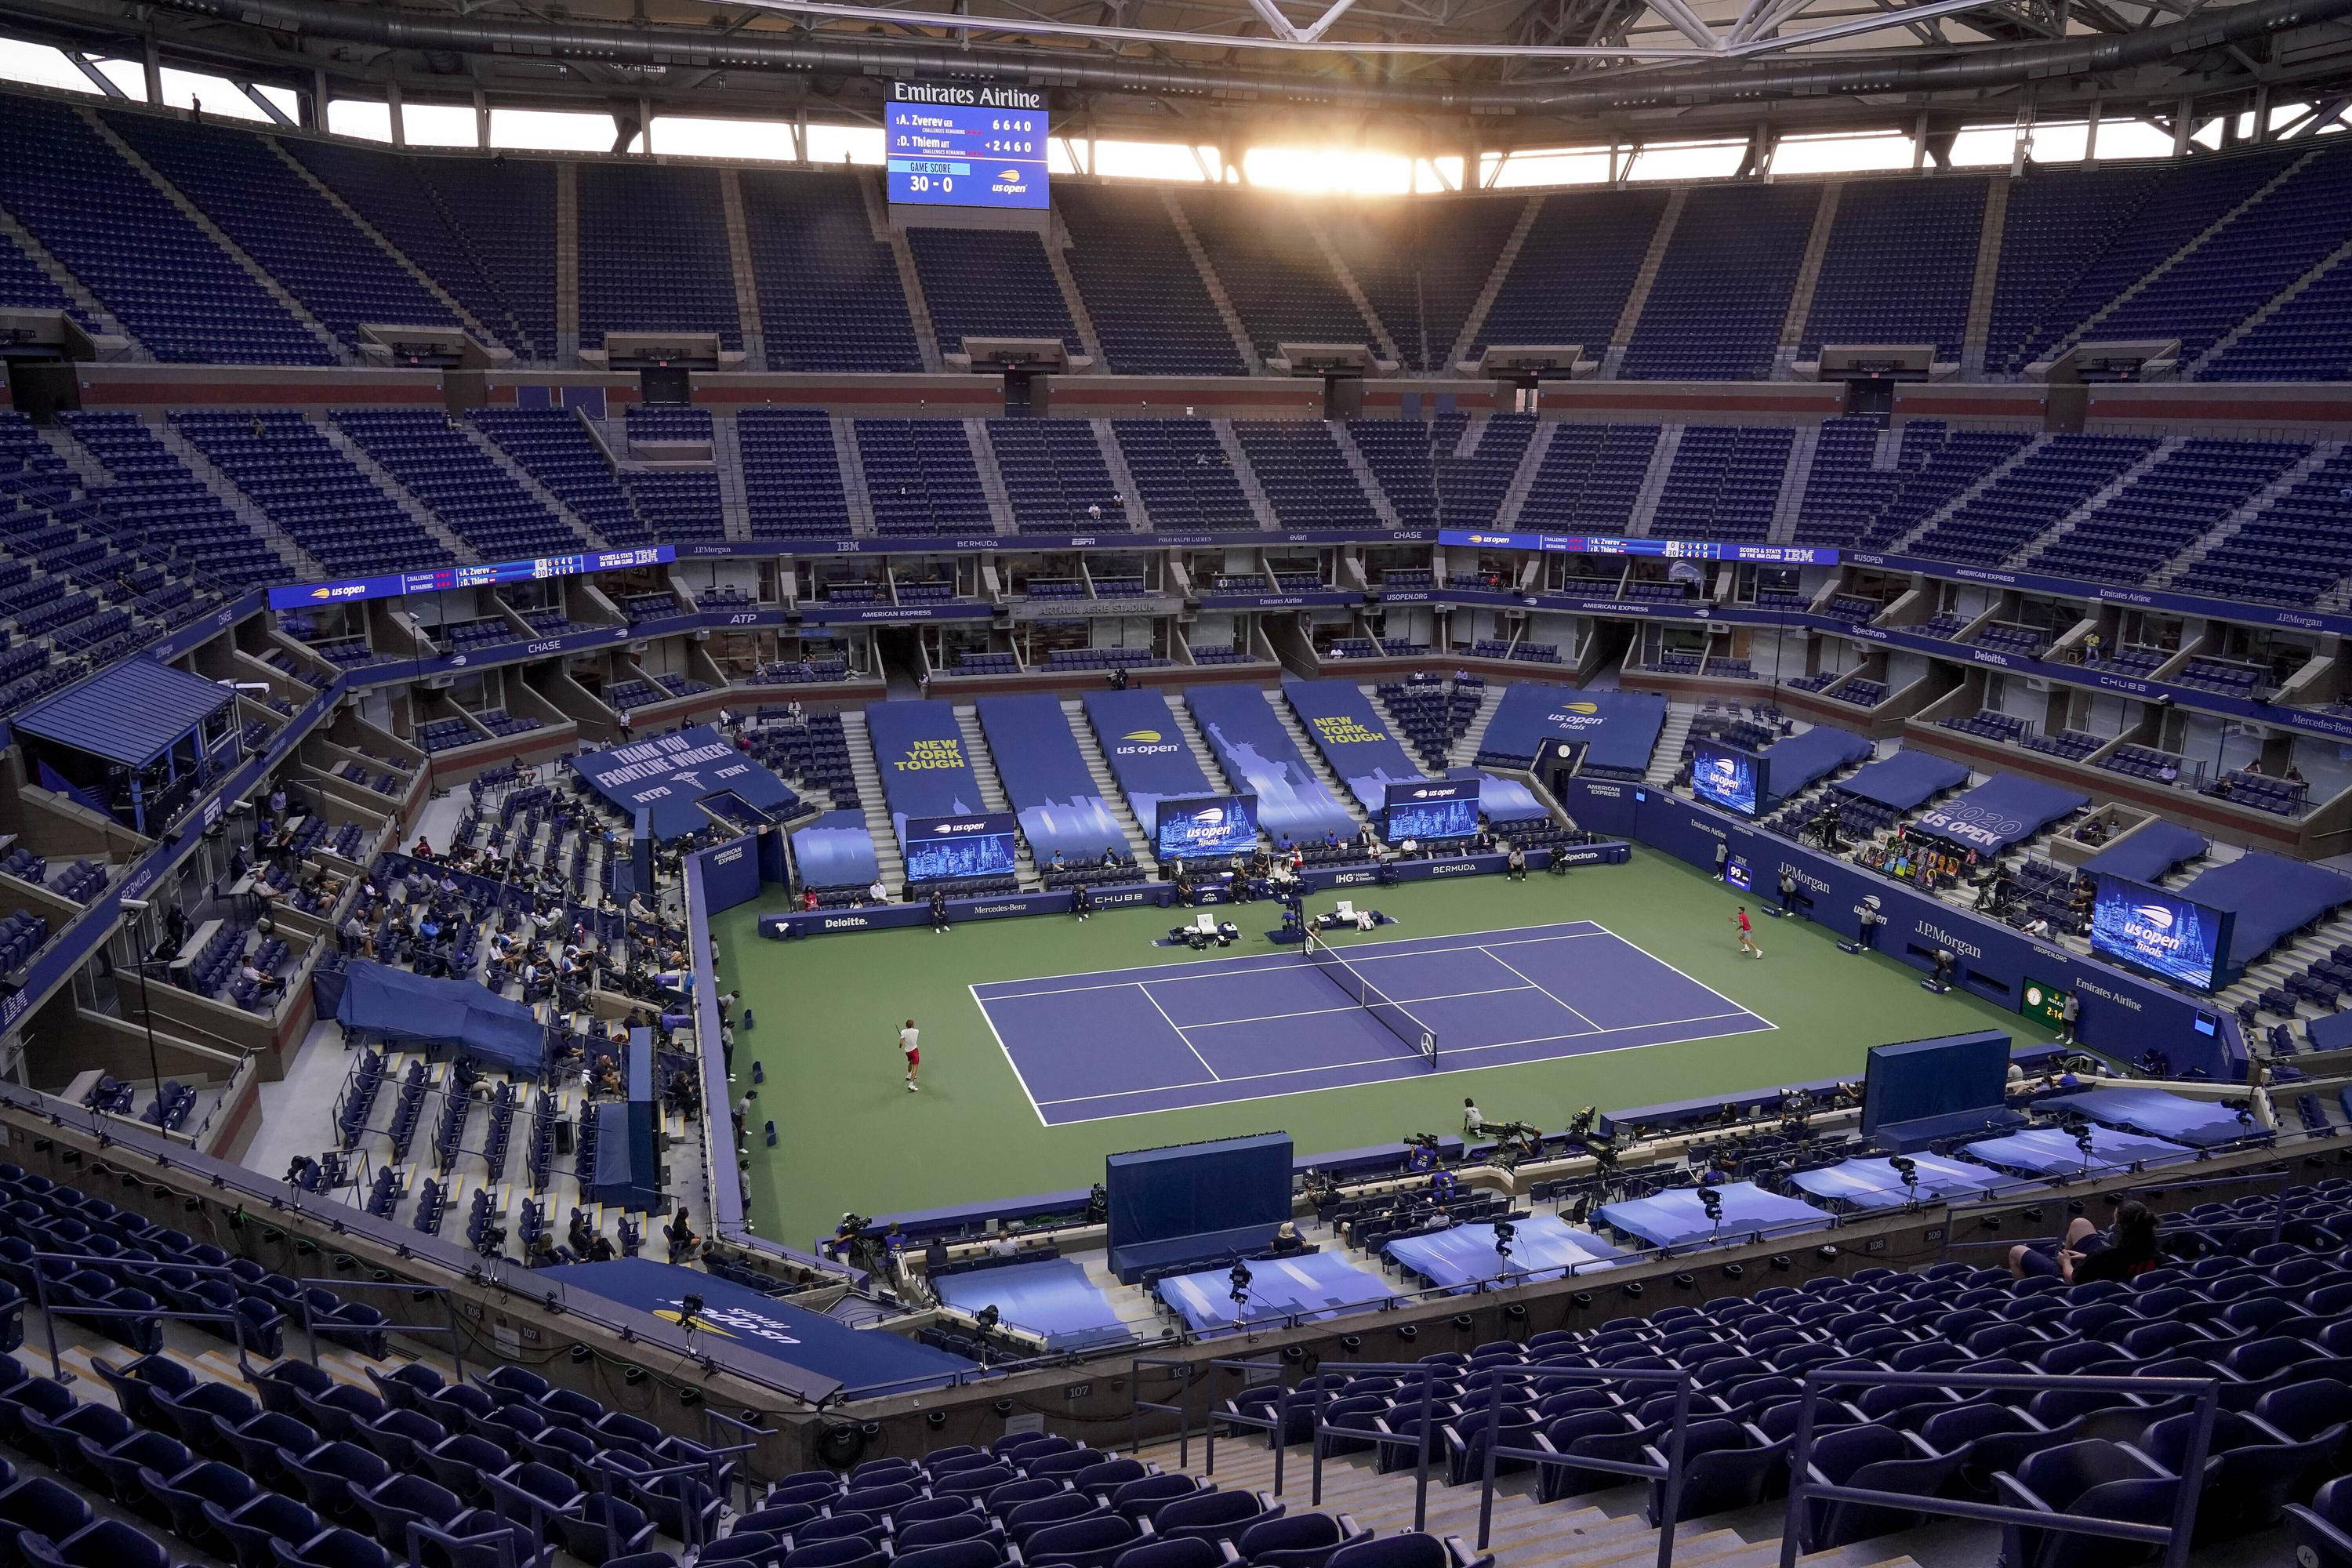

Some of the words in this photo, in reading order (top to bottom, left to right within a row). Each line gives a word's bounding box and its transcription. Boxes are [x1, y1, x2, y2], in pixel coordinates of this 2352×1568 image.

[895, 82, 974, 104] Emirates
[979, 87, 1040, 108] Airline
[900, 114, 909, 125] A.
[912, 114, 943, 127] Zverev
[993, 119, 1000, 130] 6
[1003, 120, 1010, 131] 6
[1013, 120, 1021, 131] 4
[1024, 121, 1031, 132] 0
[901, 136, 910, 147] D.
[912, 136, 939, 147] Thiem
[993, 140, 1000, 151] 2
[1004, 141, 1010, 152] 4
[1014, 142, 1021, 152] 6
[1024, 142, 1031, 153] 0
[911, 162, 928, 172] GAME
[930, 162, 951, 173] SCORE
[910, 176, 928, 191] 30
[943, 177, 952, 192] 0
[1004, 184, 1025, 194] open
[1290, 533, 1307, 542] evian
[1393, 531, 1422, 539] CHASE
[693, 546, 731, 554] J.P.Morgan
[837, 541, 859, 552] IBM
[635, 549, 658, 564] IBM
[1784, 549, 1814, 563] IBM
[1853, 554, 1883, 564] #USOPEN
[463, 568, 469, 577] A.
[470, 566, 489, 575] Zverev
[1956, 569, 1987, 580] AMERICAN
[1987, 573, 2015, 583] EXPRESS
[470, 576, 488, 585] Thiem
[343, 585, 365, 596] open
[1386, 593, 1428, 601] USOPEN.ORG
[2100, 590, 2128, 601] Emirates
[2129, 593, 2151, 603] Airline
[1038, 605, 1080, 615] ARTHUR
[1082, 604, 1109, 614] ASHE
[1112, 602, 1155, 612] STADIUM
[219, 608, 232, 626] CHASE
[730, 614, 757, 624] ATP
[2277, 613, 2322, 626] J.P.Morgan
[1852, 626, 1886, 639] Spectrum
[528, 640, 561, 654] CHASE
[1974, 650, 2008, 666] Deloitte.
[2100, 677, 2147, 691] CHUBB
[1313, 717, 1352, 726] NEW
[1548, 713, 1563, 722] us
[1565, 714, 1603, 726] open
[2292, 713, 2352, 735] Mercedes-Ben
[1318, 725, 1368, 734] YORK
[1559, 722, 1586, 731] finals
[913, 739, 957, 750] NEW
[1324, 733, 1386, 743] TOUGH
[610, 742, 663, 767] THANK
[660, 735, 690, 751] YOU
[906, 750, 962, 760] YORK
[1117, 746, 1137, 754] us
[1139, 744, 1178, 754] open
[596, 757, 676, 788] FRONTLINE
[668, 742, 734, 769] WORKERS
[713, 764, 750, 779] FDNY
[894, 759, 964, 771] TOUGH
[1719, 776, 1739, 790] open
[632, 786, 673, 803] NYPD
[1716, 786, 1731, 797] finals
[1935, 800, 2022, 834] 2020
[964, 822, 985, 833] open
[1186, 828, 1200, 838] us
[1200, 825, 1231, 840] open
[1690, 818, 1711, 833] Emirates
[1711, 828, 1726, 839] Airline
[1922, 810, 1951, 828] US
[1952, 822, 2003, 847] OPEN
[1197, 837, 1219, 848] finals
[713, 846, 742, 862] AMERICAN
[718, 852, 743, 866] EXPRESS
[1565, 852, 1595, 862] Spectrum
[1433, 864, 1475, 873] BERMUDA
[1731, 866, 1741, 877] 99
[122, 869, 152, 900] BERMUDA
[1336, 874, 1354, 883] IHG
[1778, 862, 1830, 894] J.P.Morgan
[1094, 894, 1143, 903] CHUBB
[975, 903, 1027, 914] Mercedes-Benz
[825, 918, 868, 928] Deloitte.
[1915, 920, 1981, 959] J.P.Morgan
[2125, 920, 2141, 938] us
[2141, 928, 2180, 950] open
[2033, 946, 2067, 963] USOPEN.ORG
[2136, 941, 2163, 958] finals
[2076, 977, 2111, 1000] Emirates
[2112, 993, 2142, 1011] Airline
[2048, 997, 2064, 1008] ROLEX
[2047, 1007, 2063, 1021] 2:14
[1929, 1230, 1941, 1240] 109
[1870, 1240, 1883, 1250] 108
[523, 1327, 536, 1339] 107
[1070, 1386, 1088, 1398] 107
